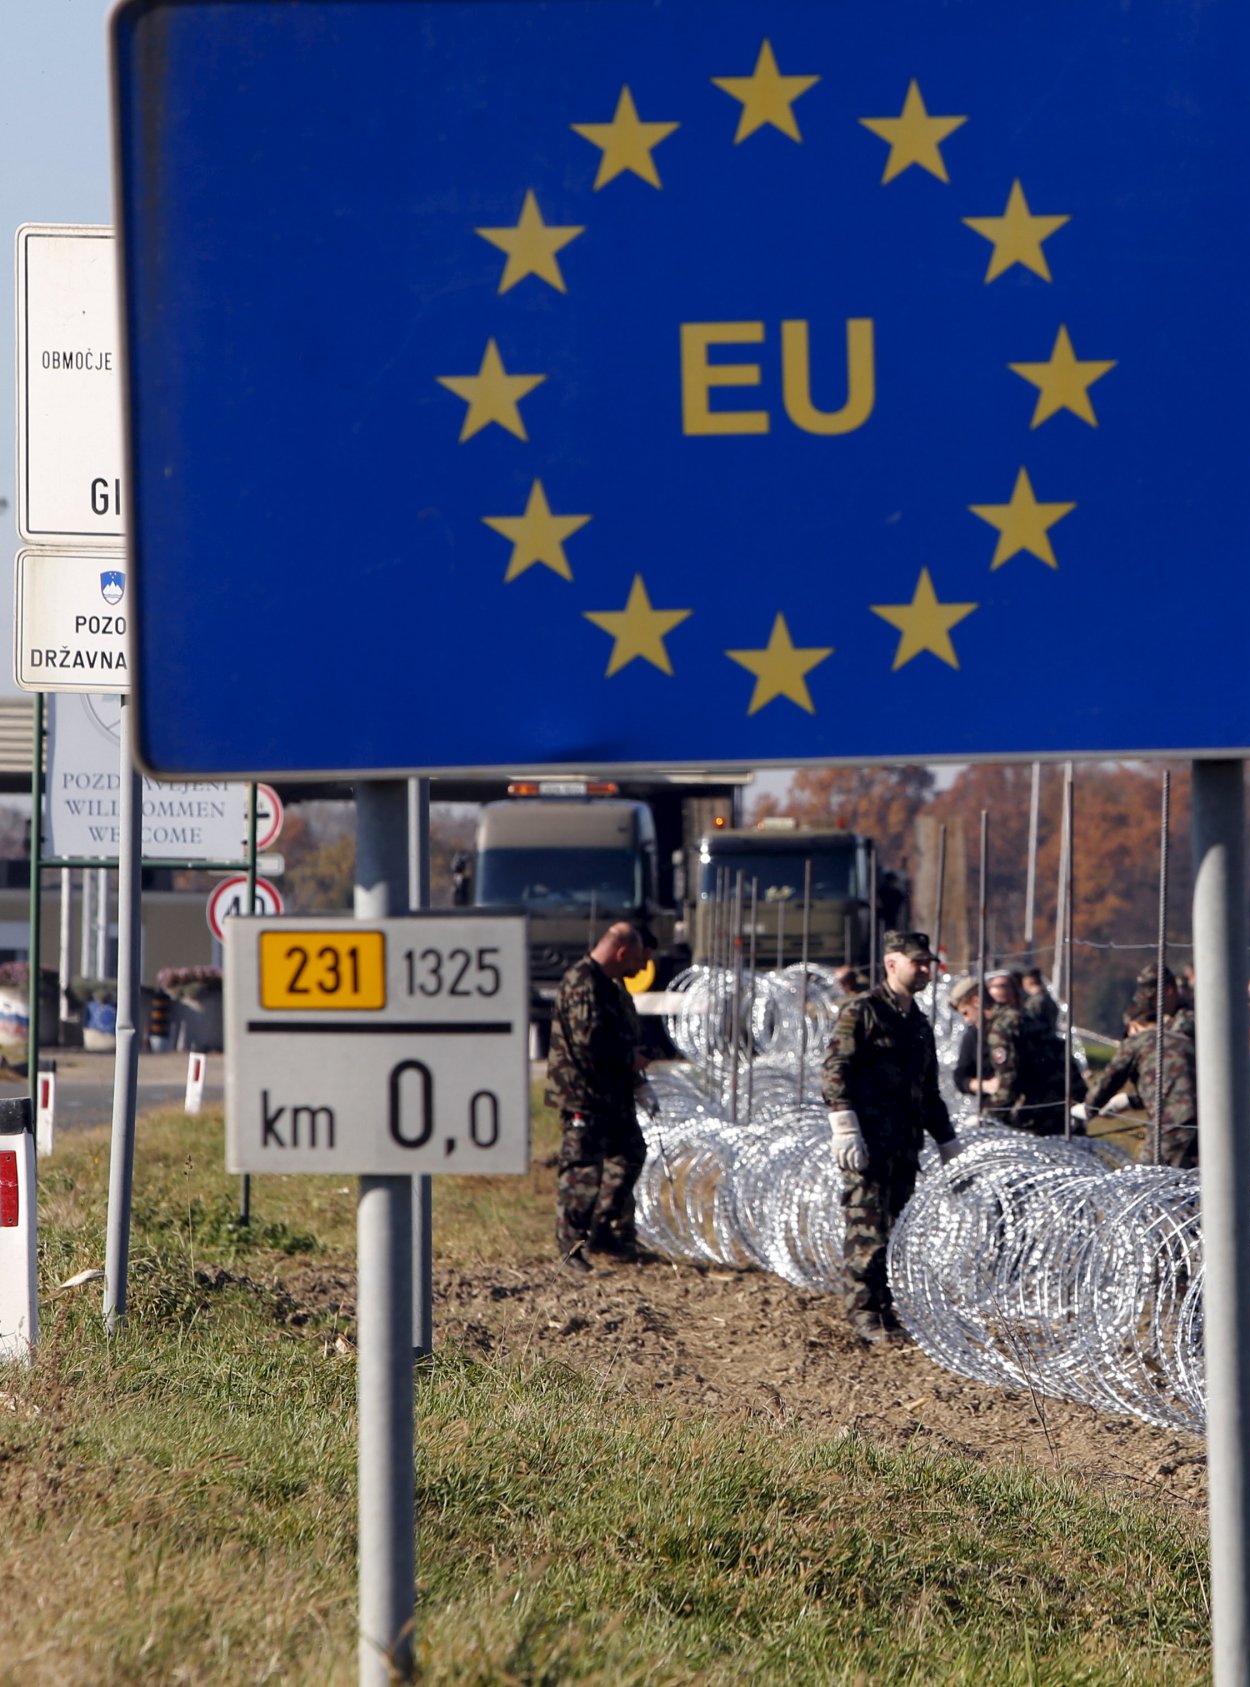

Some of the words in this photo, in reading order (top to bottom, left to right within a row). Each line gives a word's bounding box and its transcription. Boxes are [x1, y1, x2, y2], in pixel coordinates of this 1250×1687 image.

[42, 347, 112, 371] OBMOČJE
[680, 317, 875, 436] EU
[75, 615, 126, 635] POZO
[30, 645, 127, 670] DRŽAVNA
[65, 799, 226, 818] WILLOMMEN
[88, 825, 203, 844] WECOME
[285, 946, 360, 995] 231
[404, 947, 500, 997] 1325
[261, 1089, 335, 1149] km
[389, 1058, 499, 1157] 0,0
